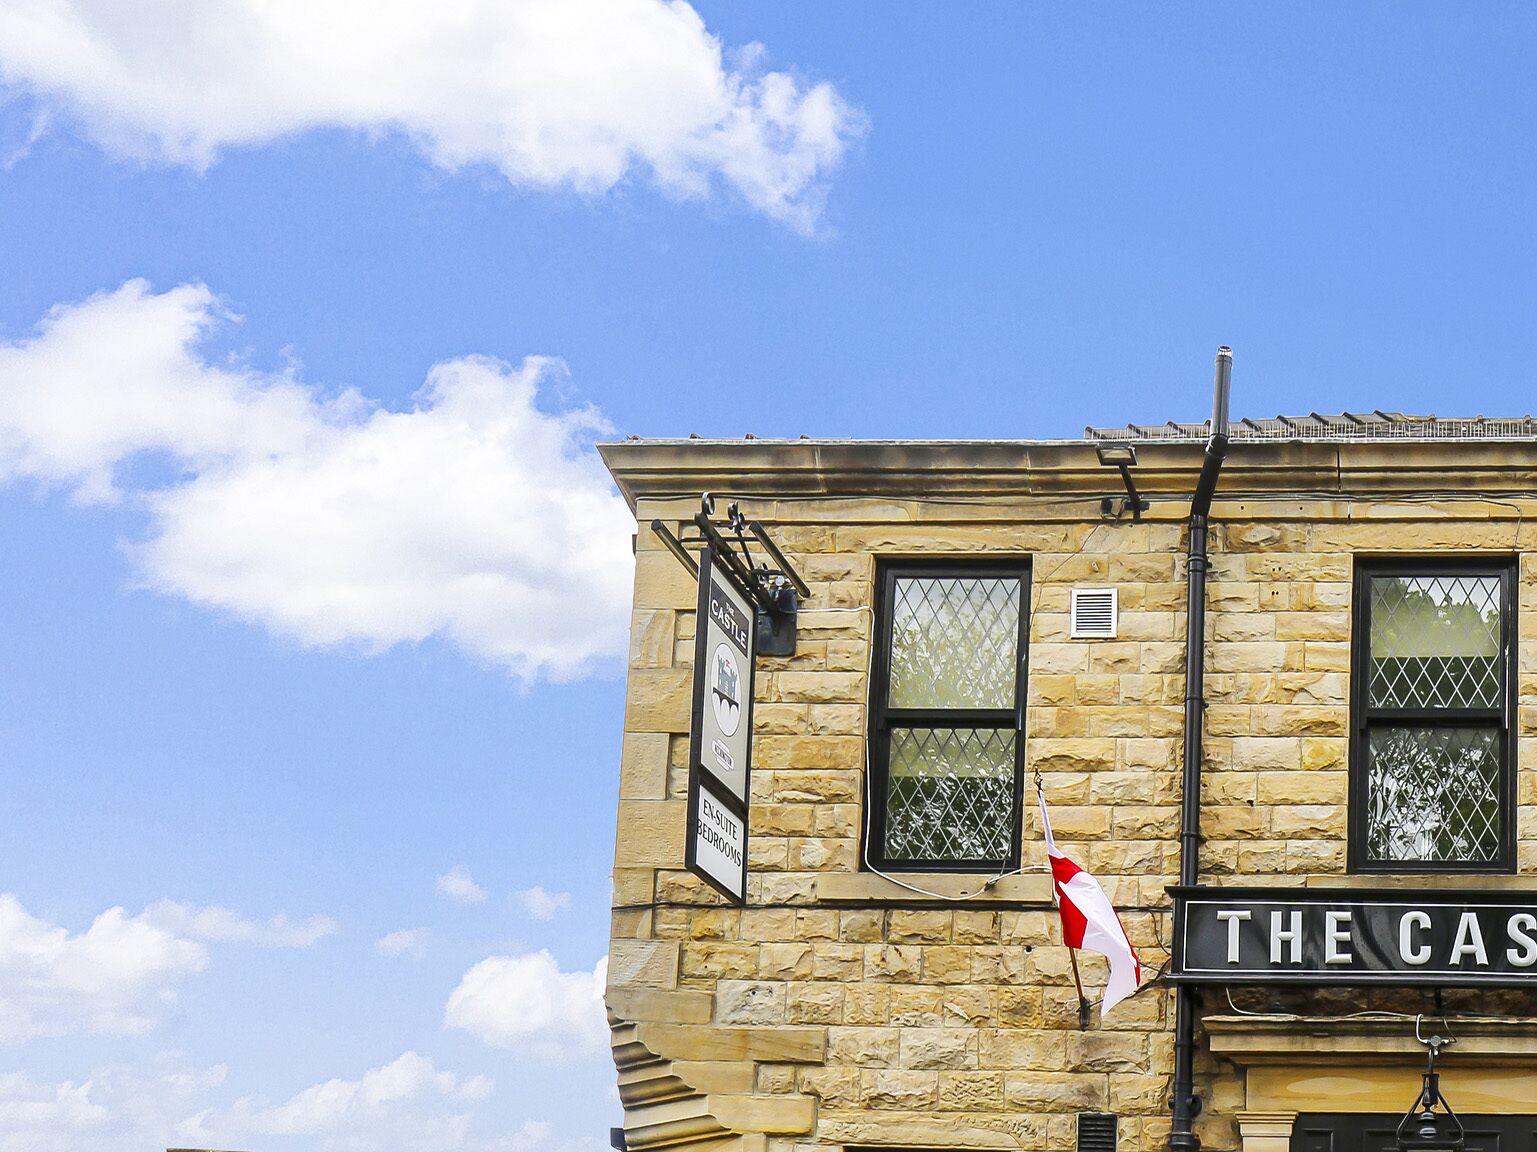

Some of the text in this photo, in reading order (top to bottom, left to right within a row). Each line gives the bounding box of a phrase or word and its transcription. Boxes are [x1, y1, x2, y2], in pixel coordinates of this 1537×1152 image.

[711, 599, 747, 649] CASTLE
[697, 818, 742, 867] BEDROOMS
[703, 798, 738, 841] EN-SUITE
[1216, 910, 1353, 965] THE
